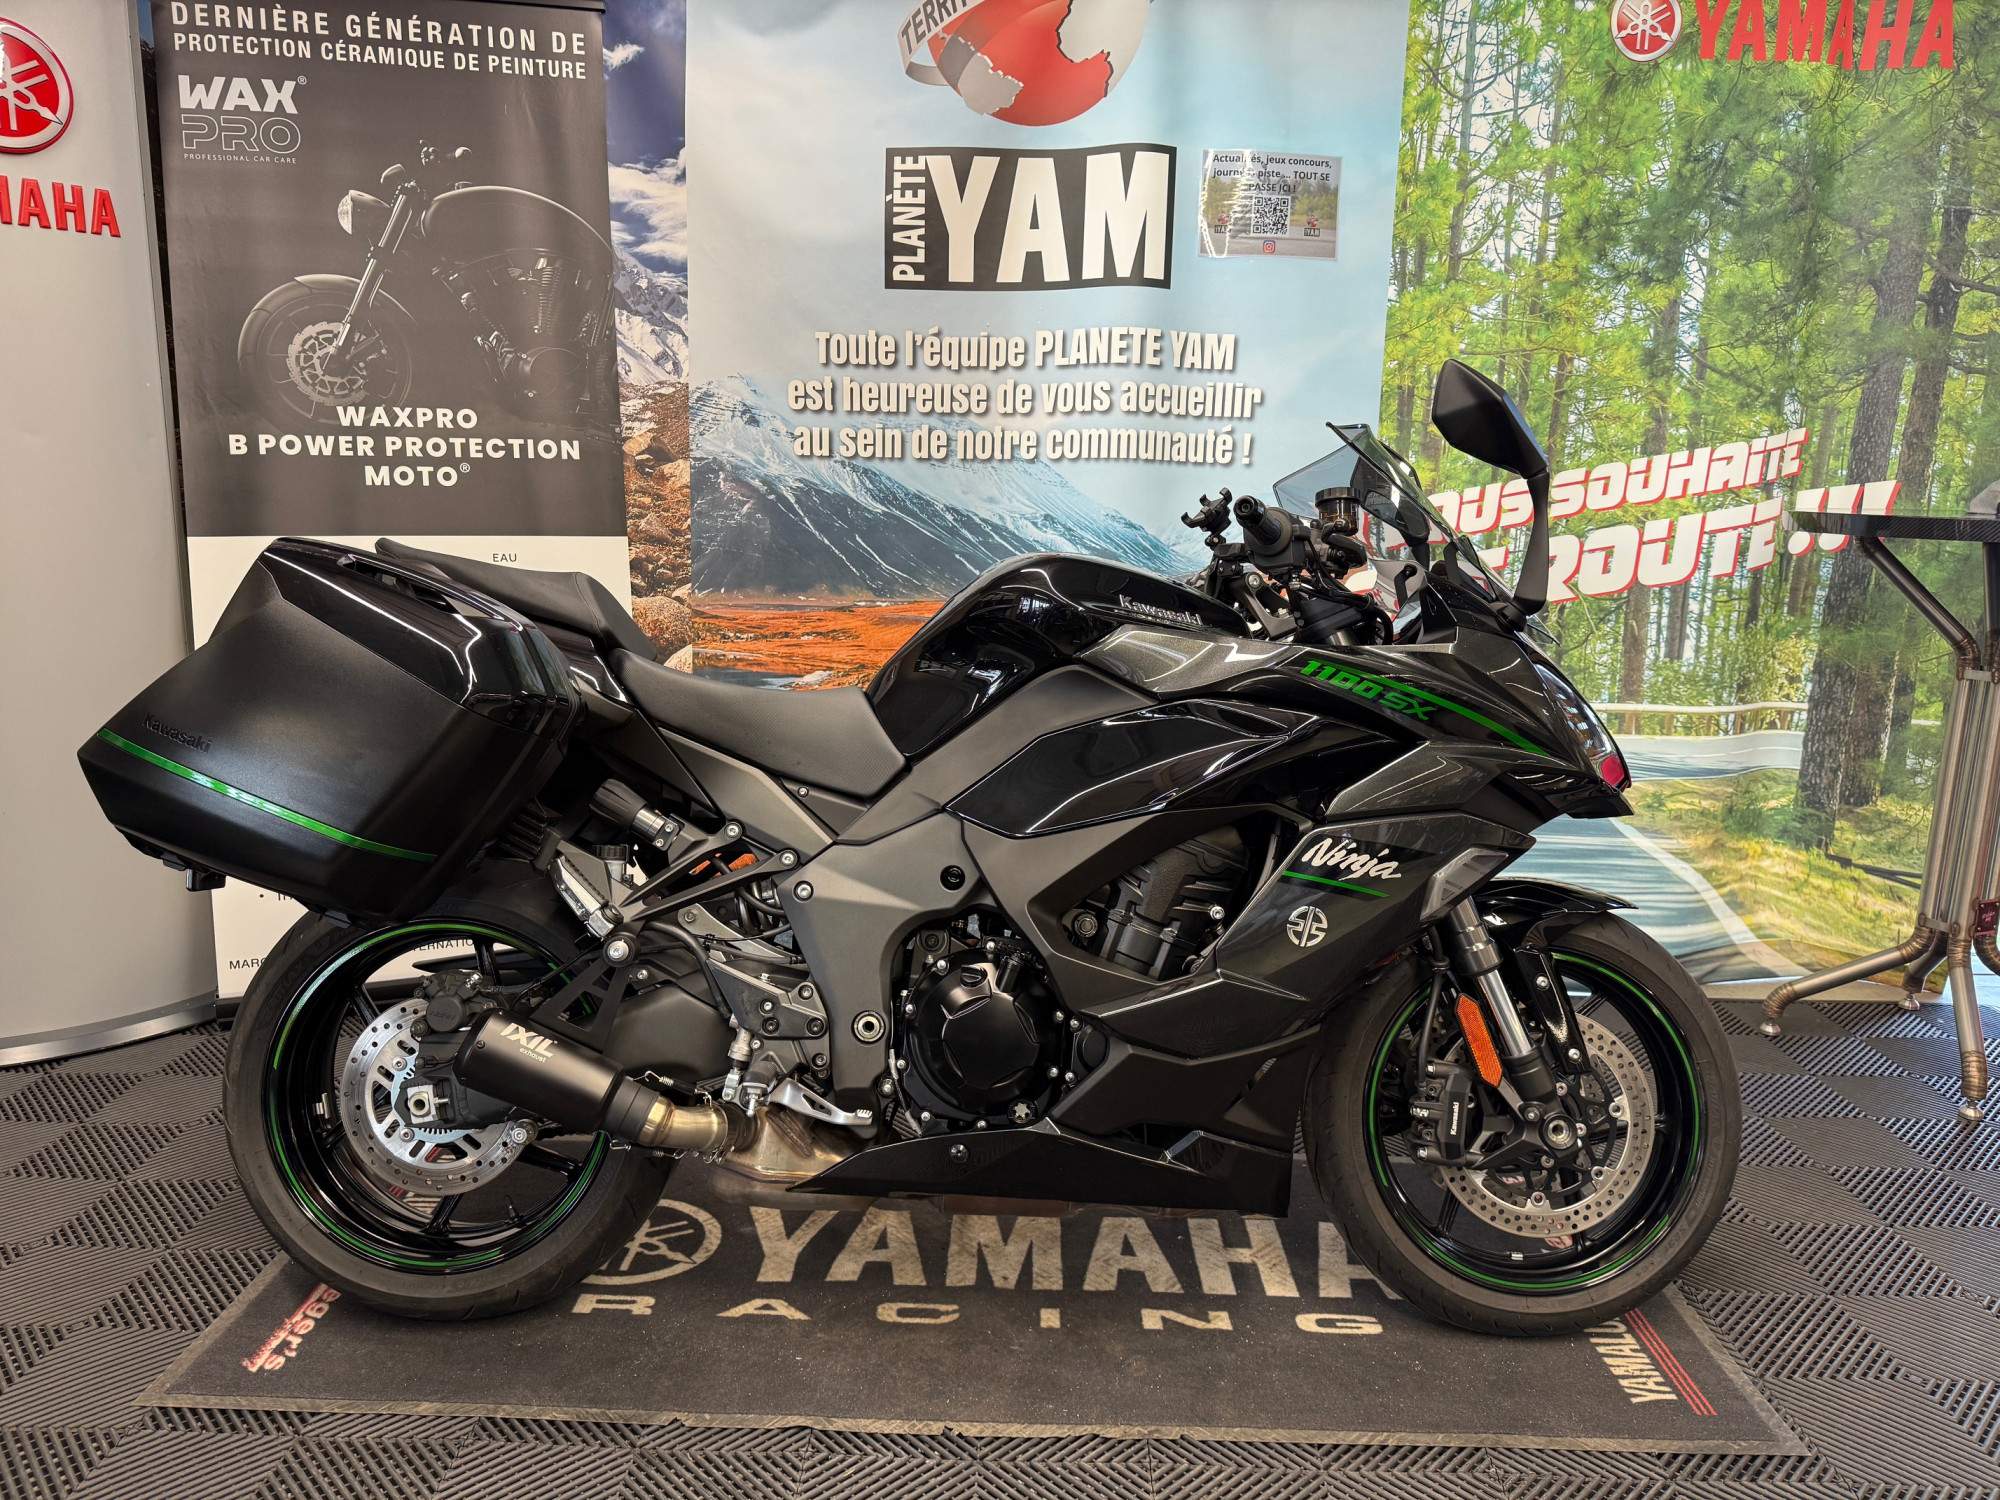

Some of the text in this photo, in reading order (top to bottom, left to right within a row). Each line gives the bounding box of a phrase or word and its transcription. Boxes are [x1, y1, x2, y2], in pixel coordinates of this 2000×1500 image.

[171, 1, 587, 56] DERNIÈRE GÉNÉRATION DE
[1695, 0, 1954, 70] YAMAHA
[173, 32, 587, 81] PROTECTION CÉRAMIQUE DE PEINTURE
[181, 113, 301, 154] PRO
[183, 153, 297, 165] PROFESSIONAL CAR CARE
[1265, 155, 1287, 166] jeux
[1288, 157, 1332, 169] concours,
[1294, 171, 1318, 181] TOUT
[1320, 173, 1330, 182] SE
[1249, 183, 1277, 192] PASSE
[886, 155, 926, 282] PLANÈTE
[925, 151, 1170, 283] YAM
[815, 330, 896, 366] Toute
[1035, 327, 1162, 366] PLANETE
[1170, 330, 1236, 370] YAM
[336, 406, 478, 429] WAXPRO
[788, 376, 1262, 418] est heureuse de vous accueillir
[228, 433, 581, 460] B POWER PROTECTION
[793, 424, 1252, 464] au sein de notre communauté !
[492, 553, 517, 563] EAU
[1547, 497, 1784, 604] ROUTE
[1119, 594, 1203, 626] Kawasaki
[1301, 659, 1438, 721] 1100 SX
[142, 712, 213, 754] Kawasaki
[1301, 838, 1402, 881] Ninja
[500, 1022, 554, 1058] IXIL
[519, 1046, 547, 1063] exhaust
[571, 1294, 1385, 1336] RACING
[1583, 1316, 1678, 1404] YAMALU
